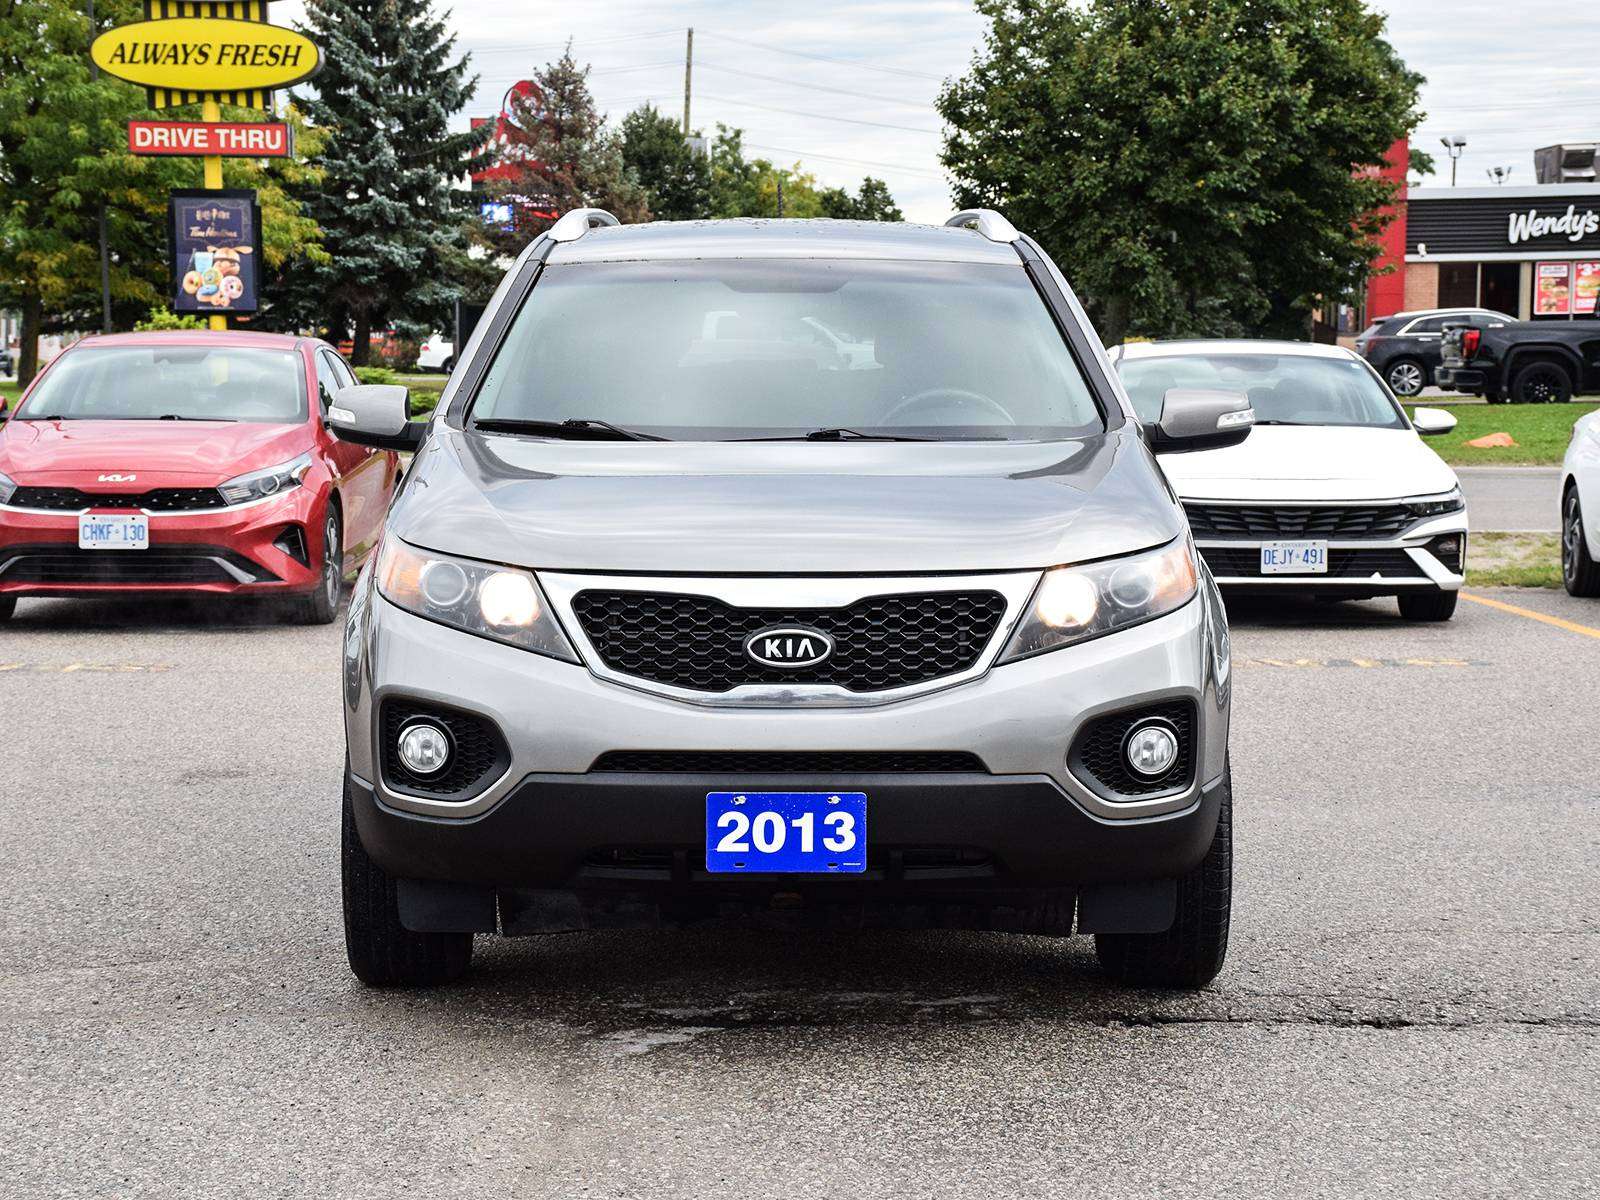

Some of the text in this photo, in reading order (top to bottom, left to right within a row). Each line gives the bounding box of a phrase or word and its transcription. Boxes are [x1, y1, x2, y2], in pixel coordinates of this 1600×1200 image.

[109, 42, 302, 67] ALWAYS FRESH
[134, 127, 282, 150] DRIVE THRU
[1508, 204, 1600, 244] Wendy's
[123, 524, 145, 541] 130
[1264, 549, 1324, 565] DEJY 491
[765, 638, 816, 658] KIA
[716, 811, 857, 853] 2013
